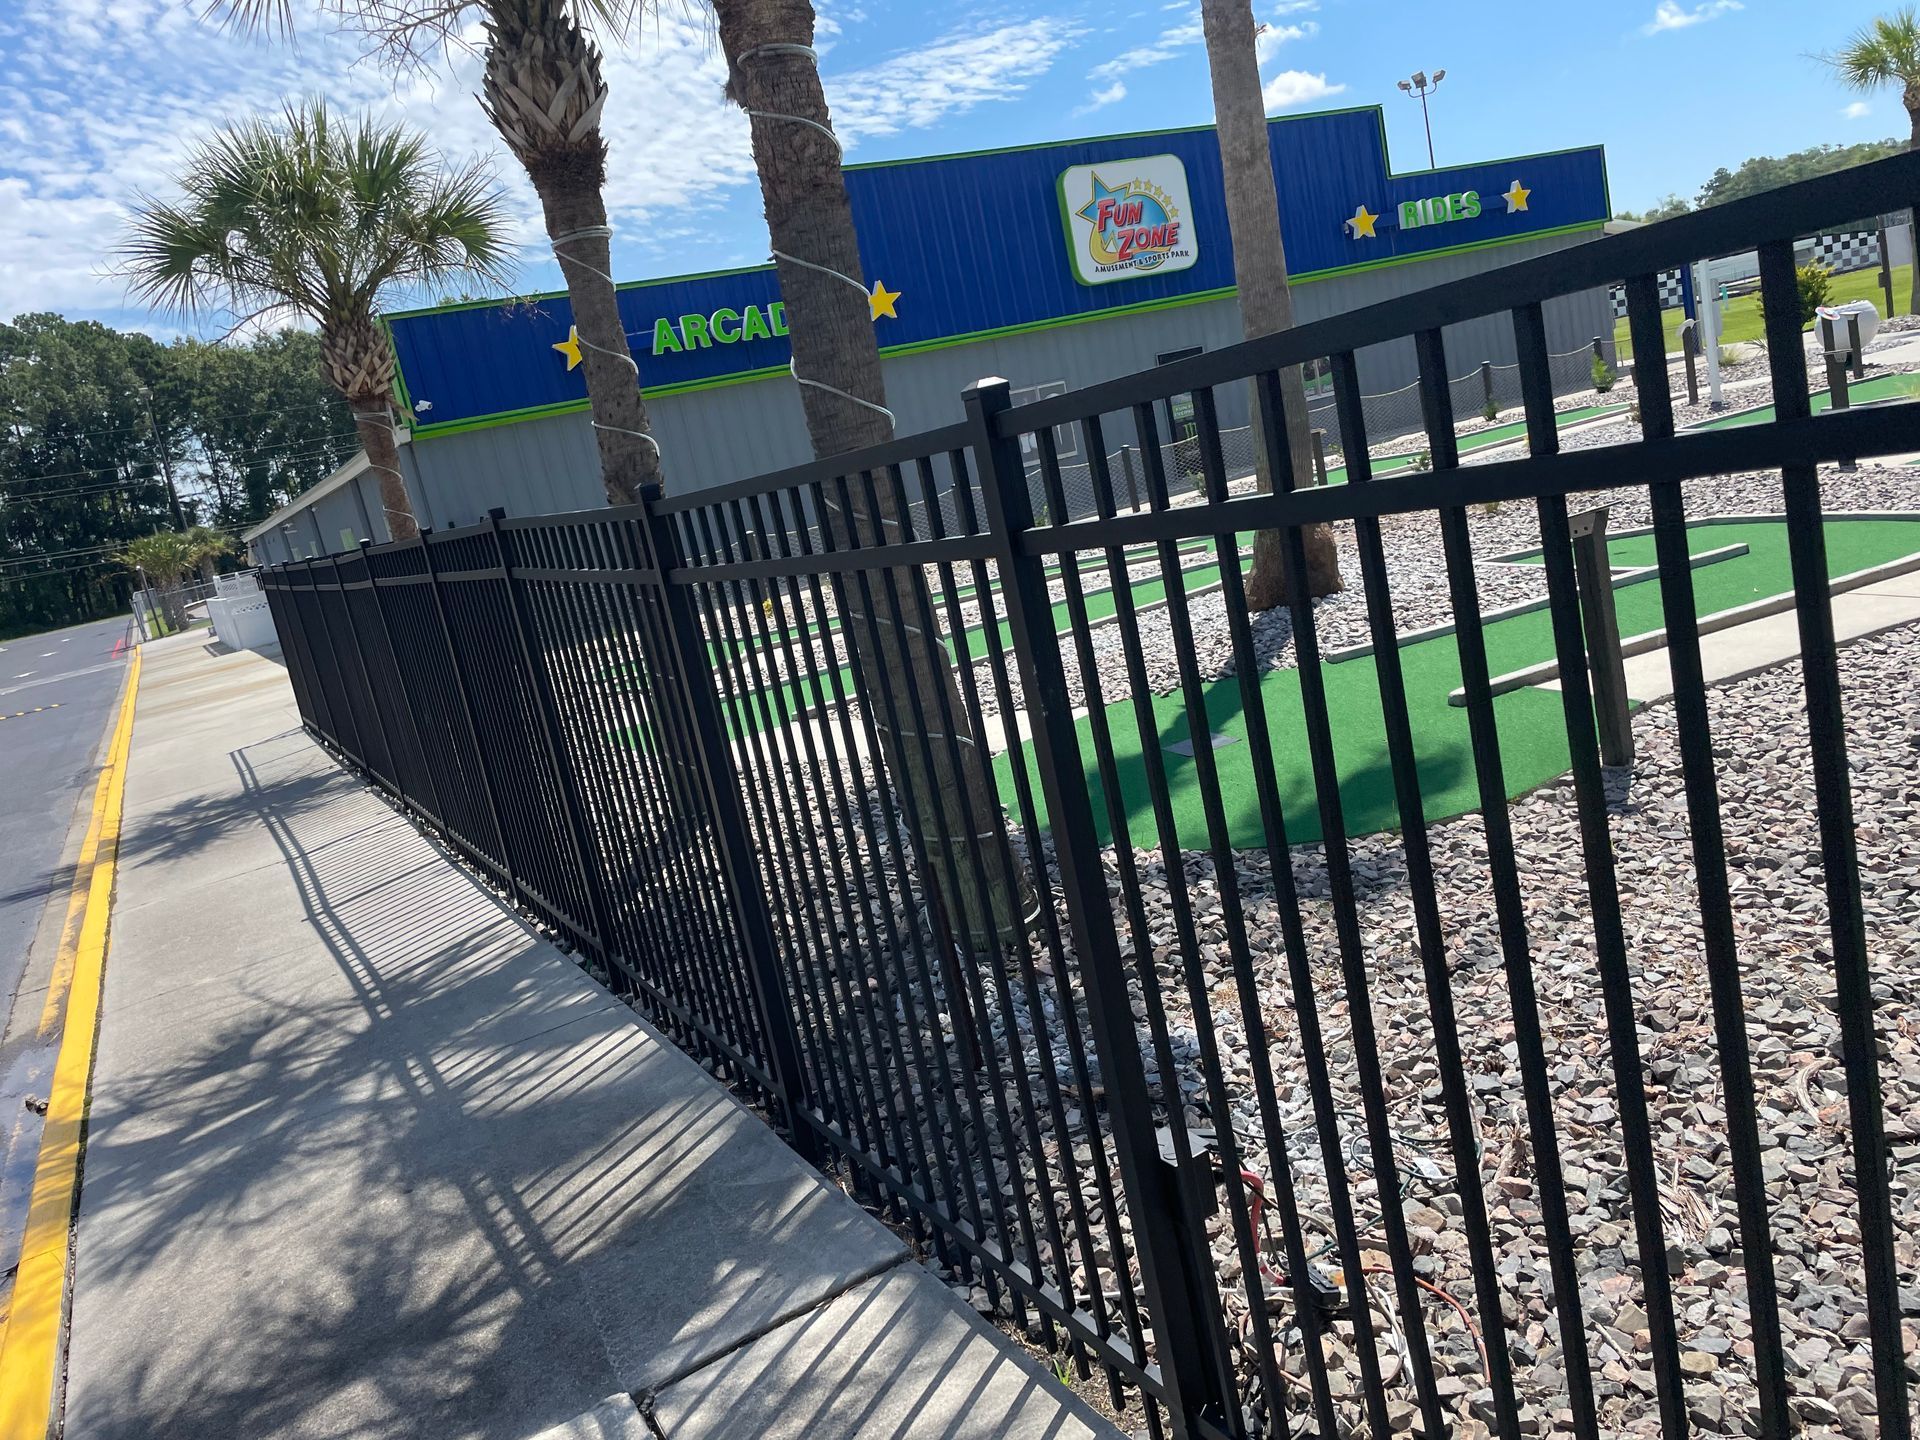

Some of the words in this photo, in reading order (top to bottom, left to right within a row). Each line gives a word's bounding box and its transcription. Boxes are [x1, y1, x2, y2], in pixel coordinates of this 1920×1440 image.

[1097, 198, 1143, 233] FUN
[1398, 190, 1482, 230] RIDES
[1095, 260, 1137, 272] AMUSEMENT
[1144, 253, 1169, 263] SPORTS
[1171, 250, 1189, 258] PARK
[1117, 222, 1180, 261] ZONE
[653, 302, 789, 355] ARCAD
